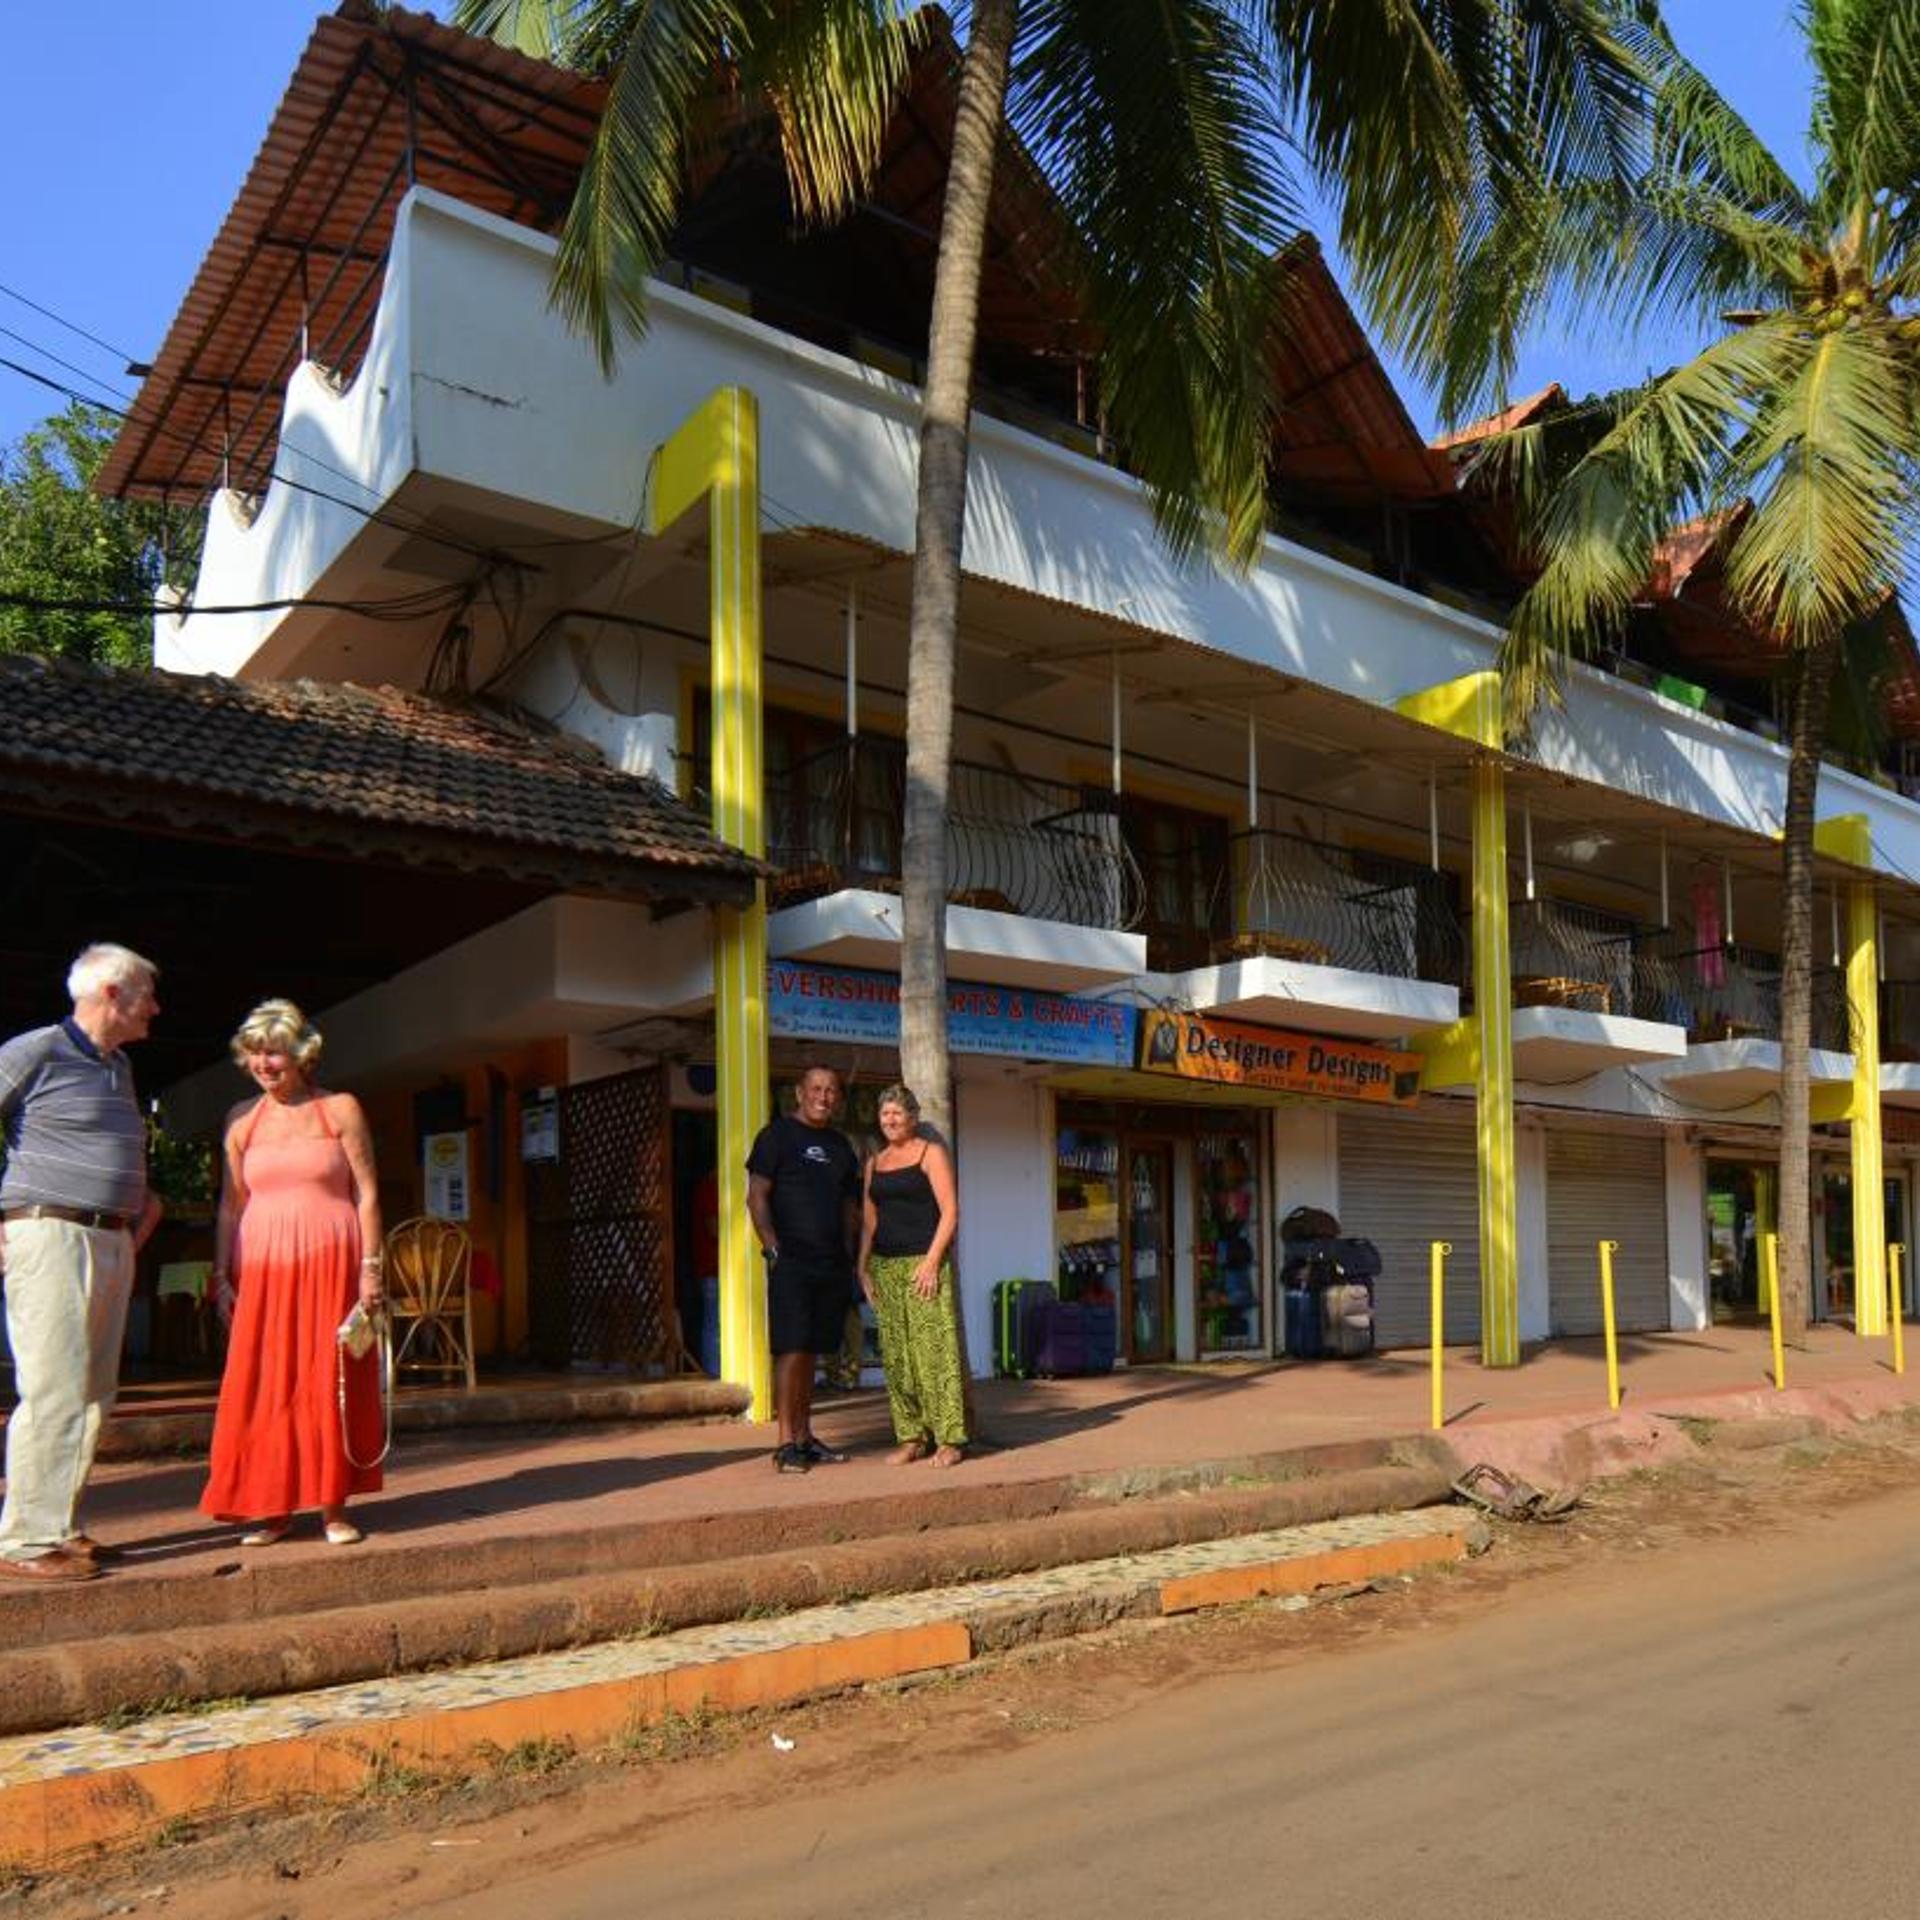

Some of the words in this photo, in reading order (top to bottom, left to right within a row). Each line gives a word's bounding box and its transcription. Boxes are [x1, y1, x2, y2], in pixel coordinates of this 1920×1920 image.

[766, 966, 901, 1004] EVERSHIN
[949, 991, 999, 1017] RTS
[1033, 1001, 1122, 1033] CRAFTS
[1187, 1026, 1297, 1071] Designer
[1308, 1045, 1391, 1085] Designs
